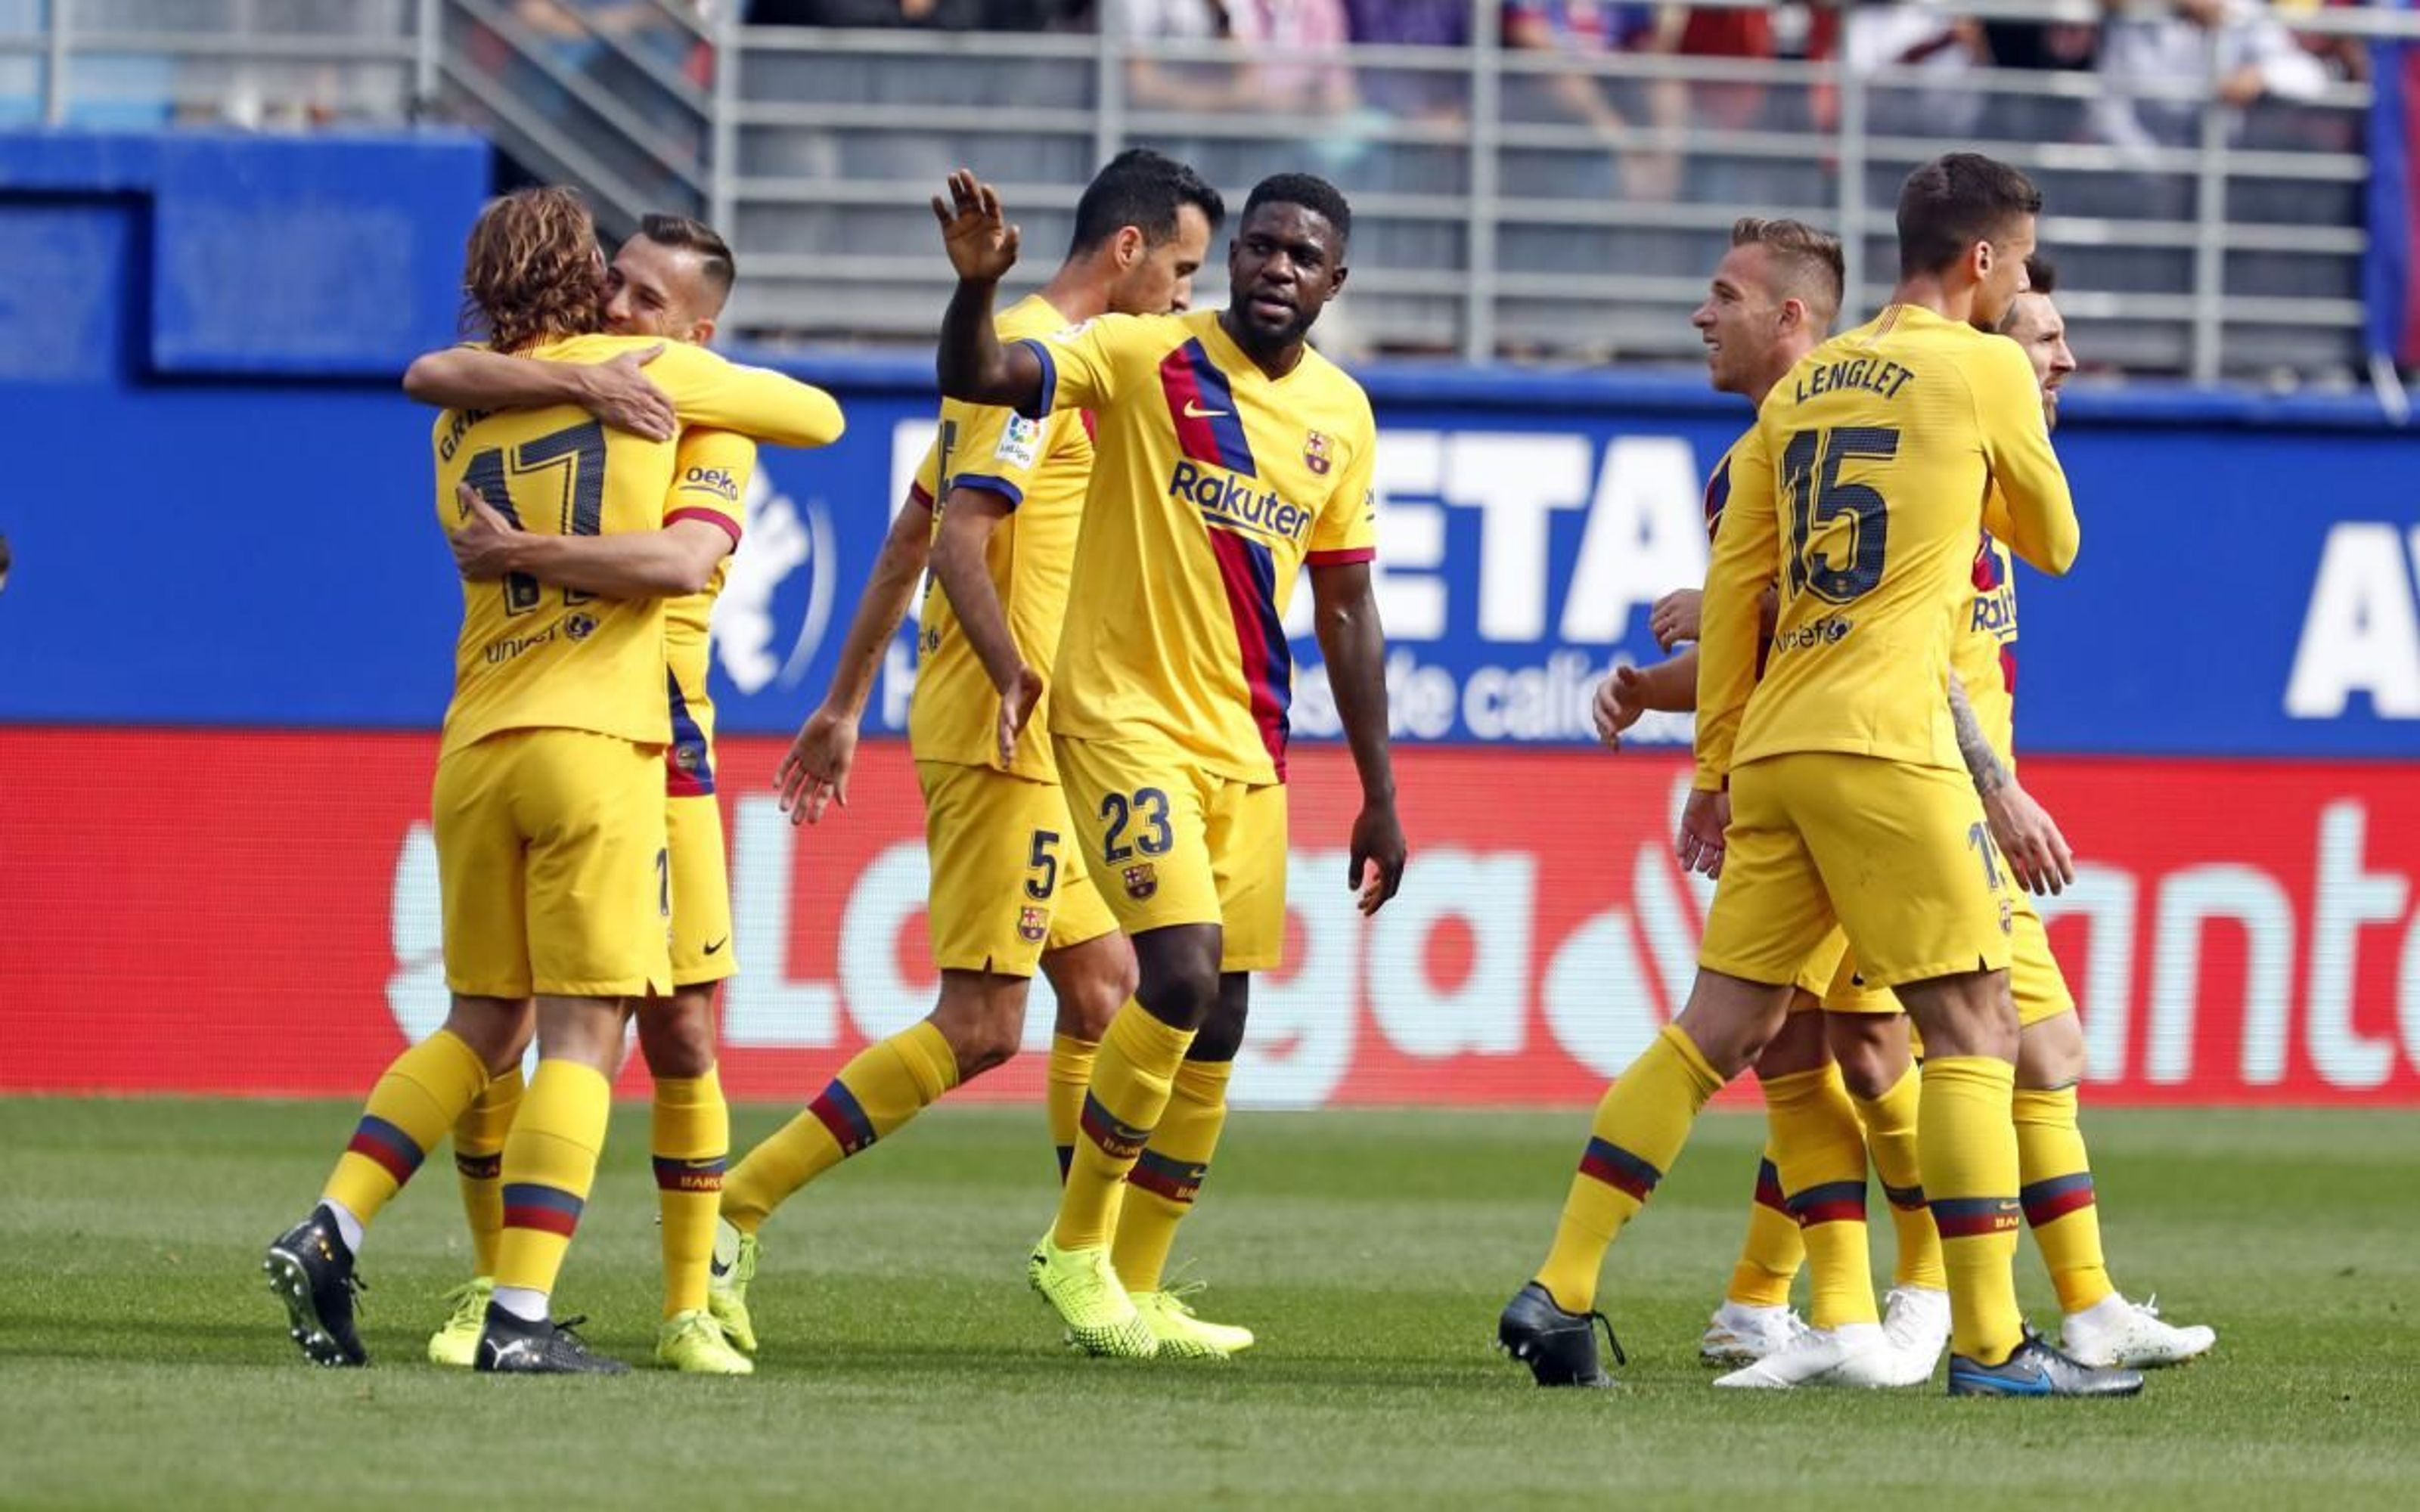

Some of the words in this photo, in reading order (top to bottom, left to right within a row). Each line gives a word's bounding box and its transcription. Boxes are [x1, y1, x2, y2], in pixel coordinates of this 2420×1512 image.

[1796, 360, 1914, 404] LENGLET
[456, 420, 607, 618] 17
[1168, 460, 1316, 539] Rakuten
[1779, 426, 1900, 606] 15
[1025, 829, 1060, 901] 5
[1100, 787, 1174, 866] 23
[1968, 821, 2006, 892] 1
